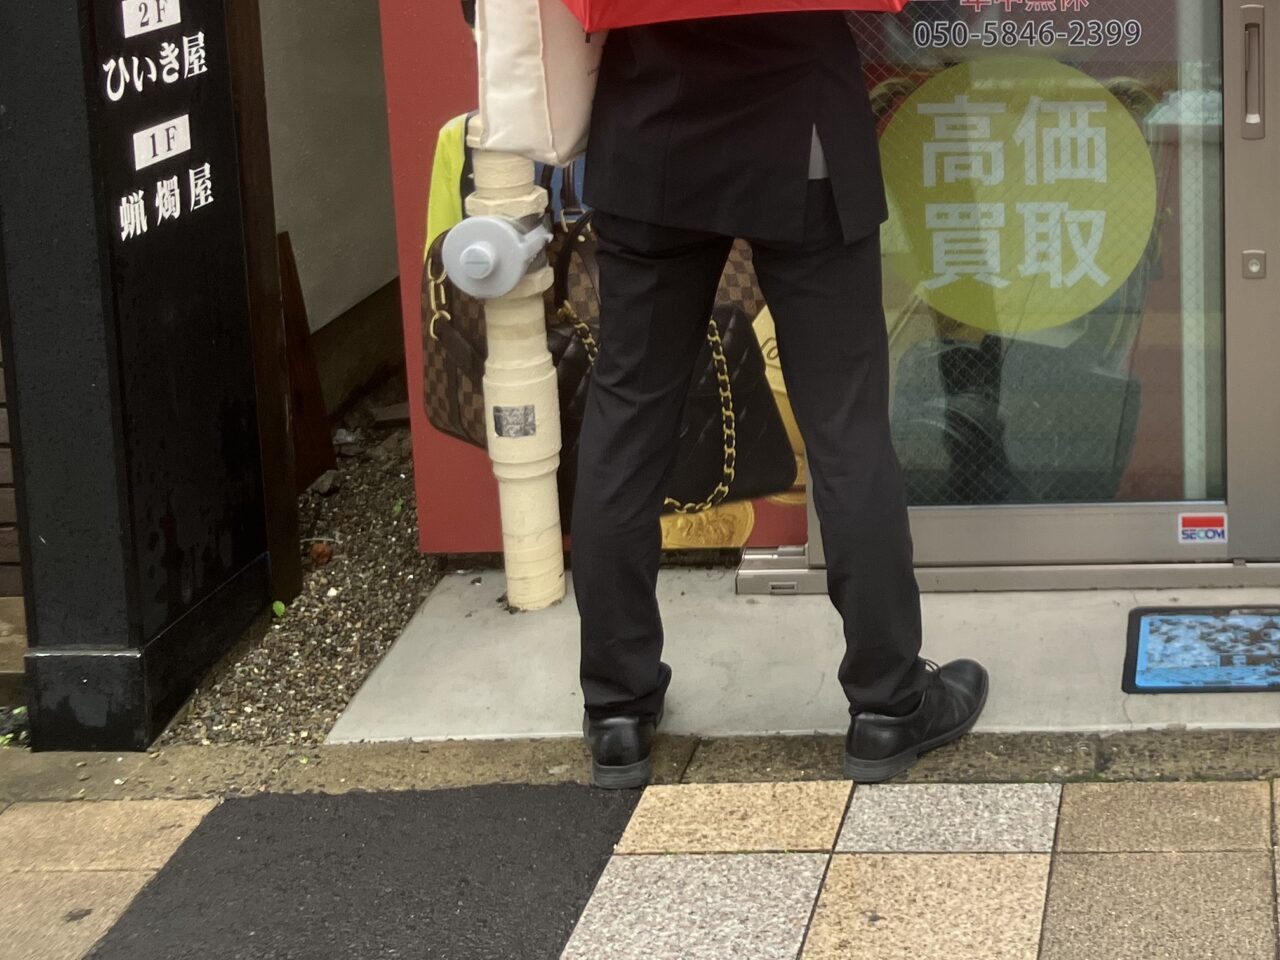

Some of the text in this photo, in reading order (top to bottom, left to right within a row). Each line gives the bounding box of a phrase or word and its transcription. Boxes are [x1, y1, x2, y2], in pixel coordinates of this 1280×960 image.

[913, 19, 1142, 48] 050-5846-2399
[102, 31, 208, 102] ひいき屋
[150, 125, 178, 159] 1F
[917, 95, 1108, 187] 高価
[925, 201, 1111, 289] 買取
[1181, 529, 1226, 540] SECOM
